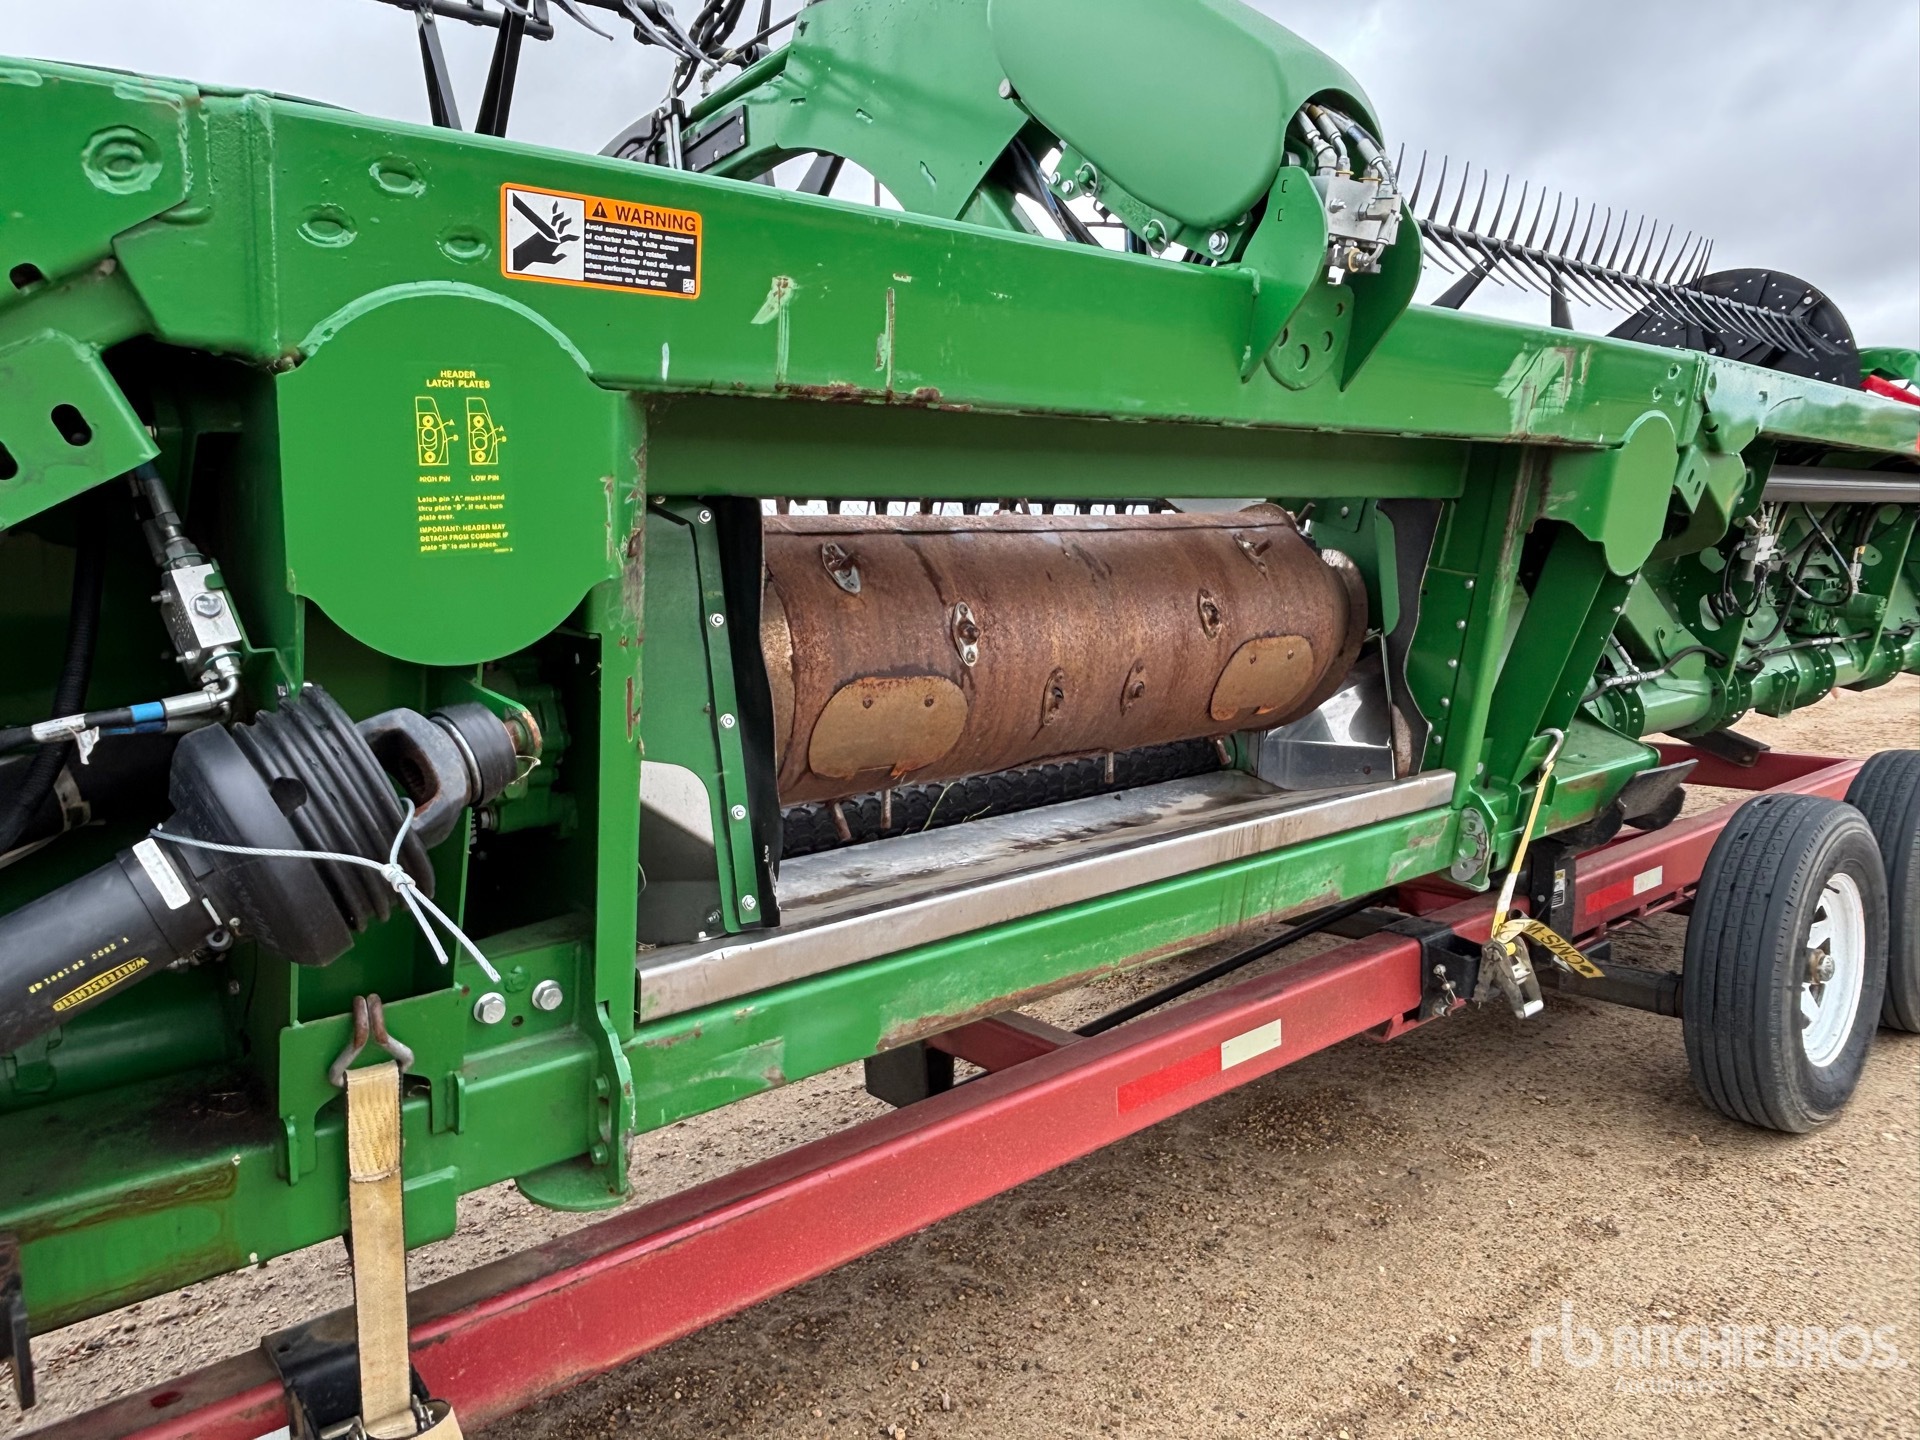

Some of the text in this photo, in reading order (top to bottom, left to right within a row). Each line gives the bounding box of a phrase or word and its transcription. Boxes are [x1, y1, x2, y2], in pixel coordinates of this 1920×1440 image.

[616, 205, 696, 232] WARNING
[440, 370, 476, 379] HEADER
[426, 379, 491, 389] LATCH PLATES
[420, 534, 448, 542] DETACH
[52, 956, 150, 1012] WALTERSCHEID
